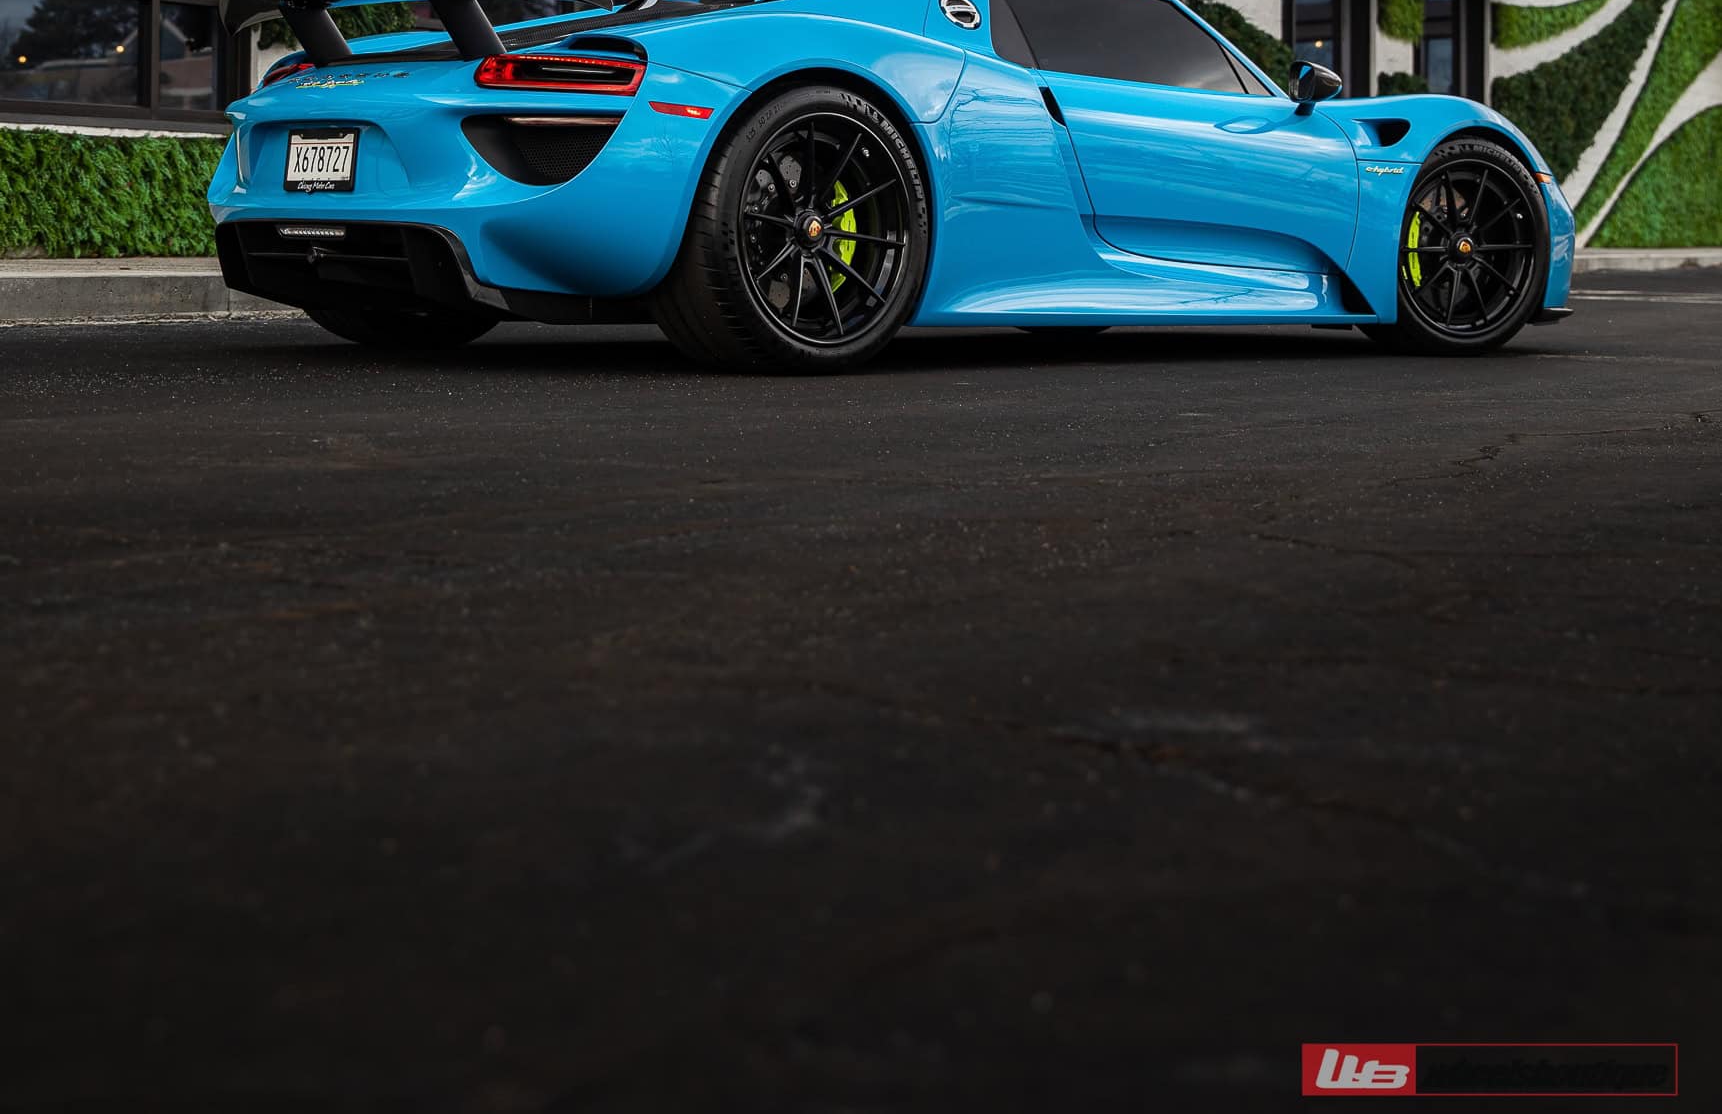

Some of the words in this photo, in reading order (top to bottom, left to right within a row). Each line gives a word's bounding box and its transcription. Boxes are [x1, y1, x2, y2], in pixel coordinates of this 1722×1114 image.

[293, 146, 350, 173] X678727
[880, 121, 925, 202] MICHELIN
[1474, 145, 1522, 176] MICHELIN
